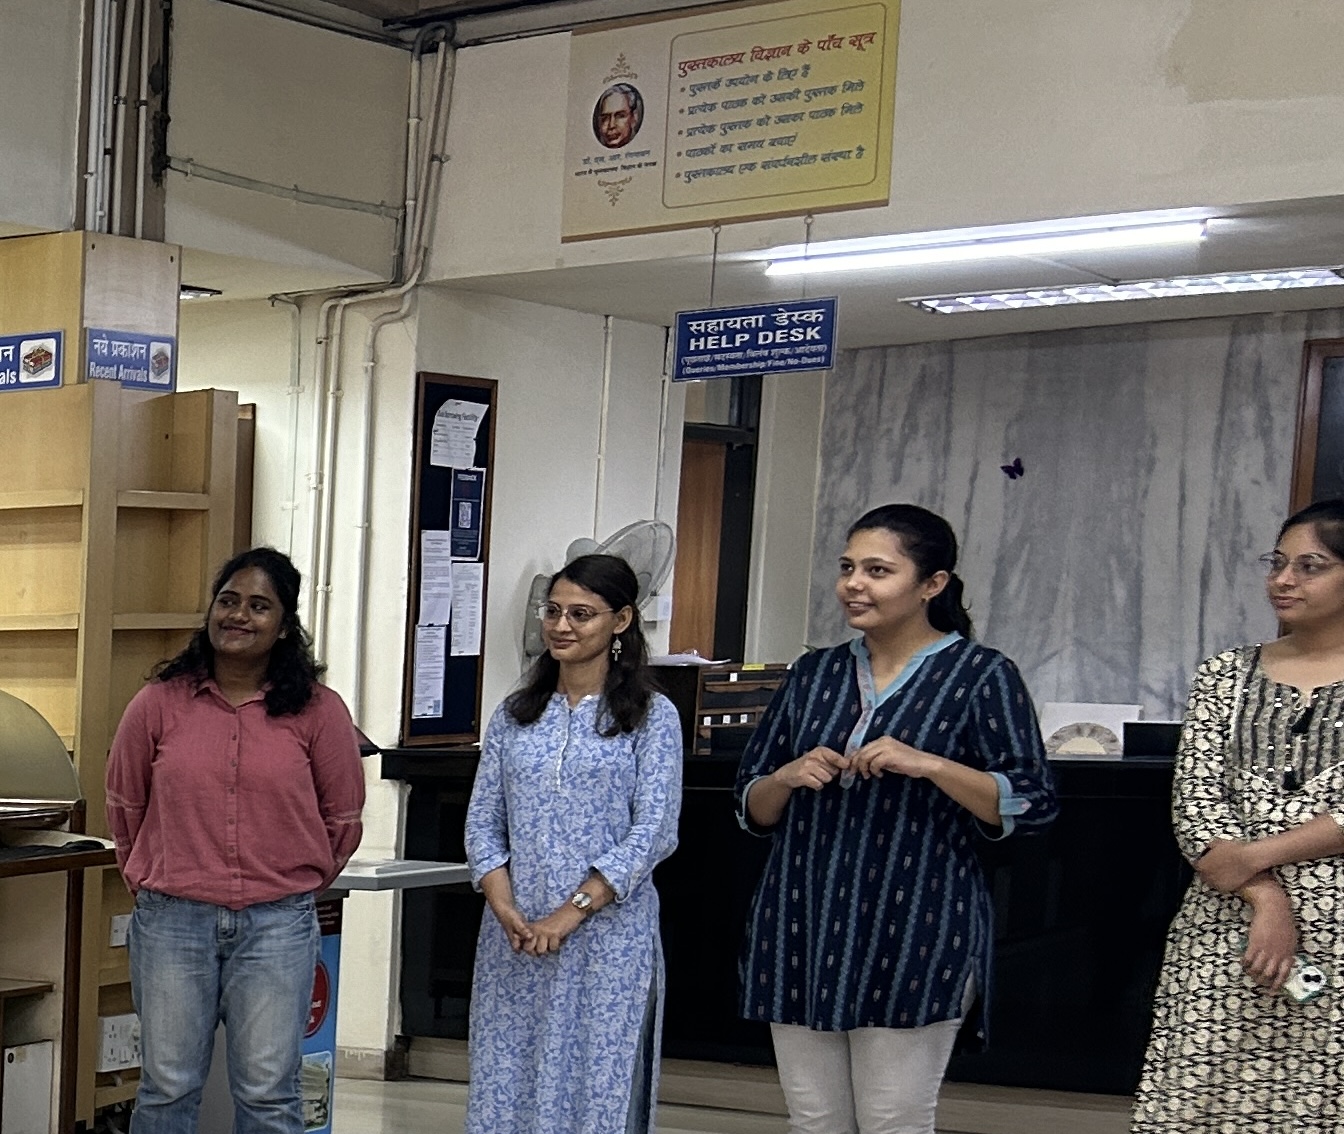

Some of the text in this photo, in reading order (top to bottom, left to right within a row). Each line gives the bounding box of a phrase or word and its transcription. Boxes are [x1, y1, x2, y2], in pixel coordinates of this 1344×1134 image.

[678, 52, 745, 78] पुस्तकालय
[750, 44, 793, 62] विज्ञान
[797, 39, 812, 54] के
[687, 308, 826, 334] सहायता डेस्क
[93, 333, 147, 360] नये प्रकाशन
[689, 326, 822, 351] HELP DESK
[89, 361, 148, 382] Recent Arrivals
